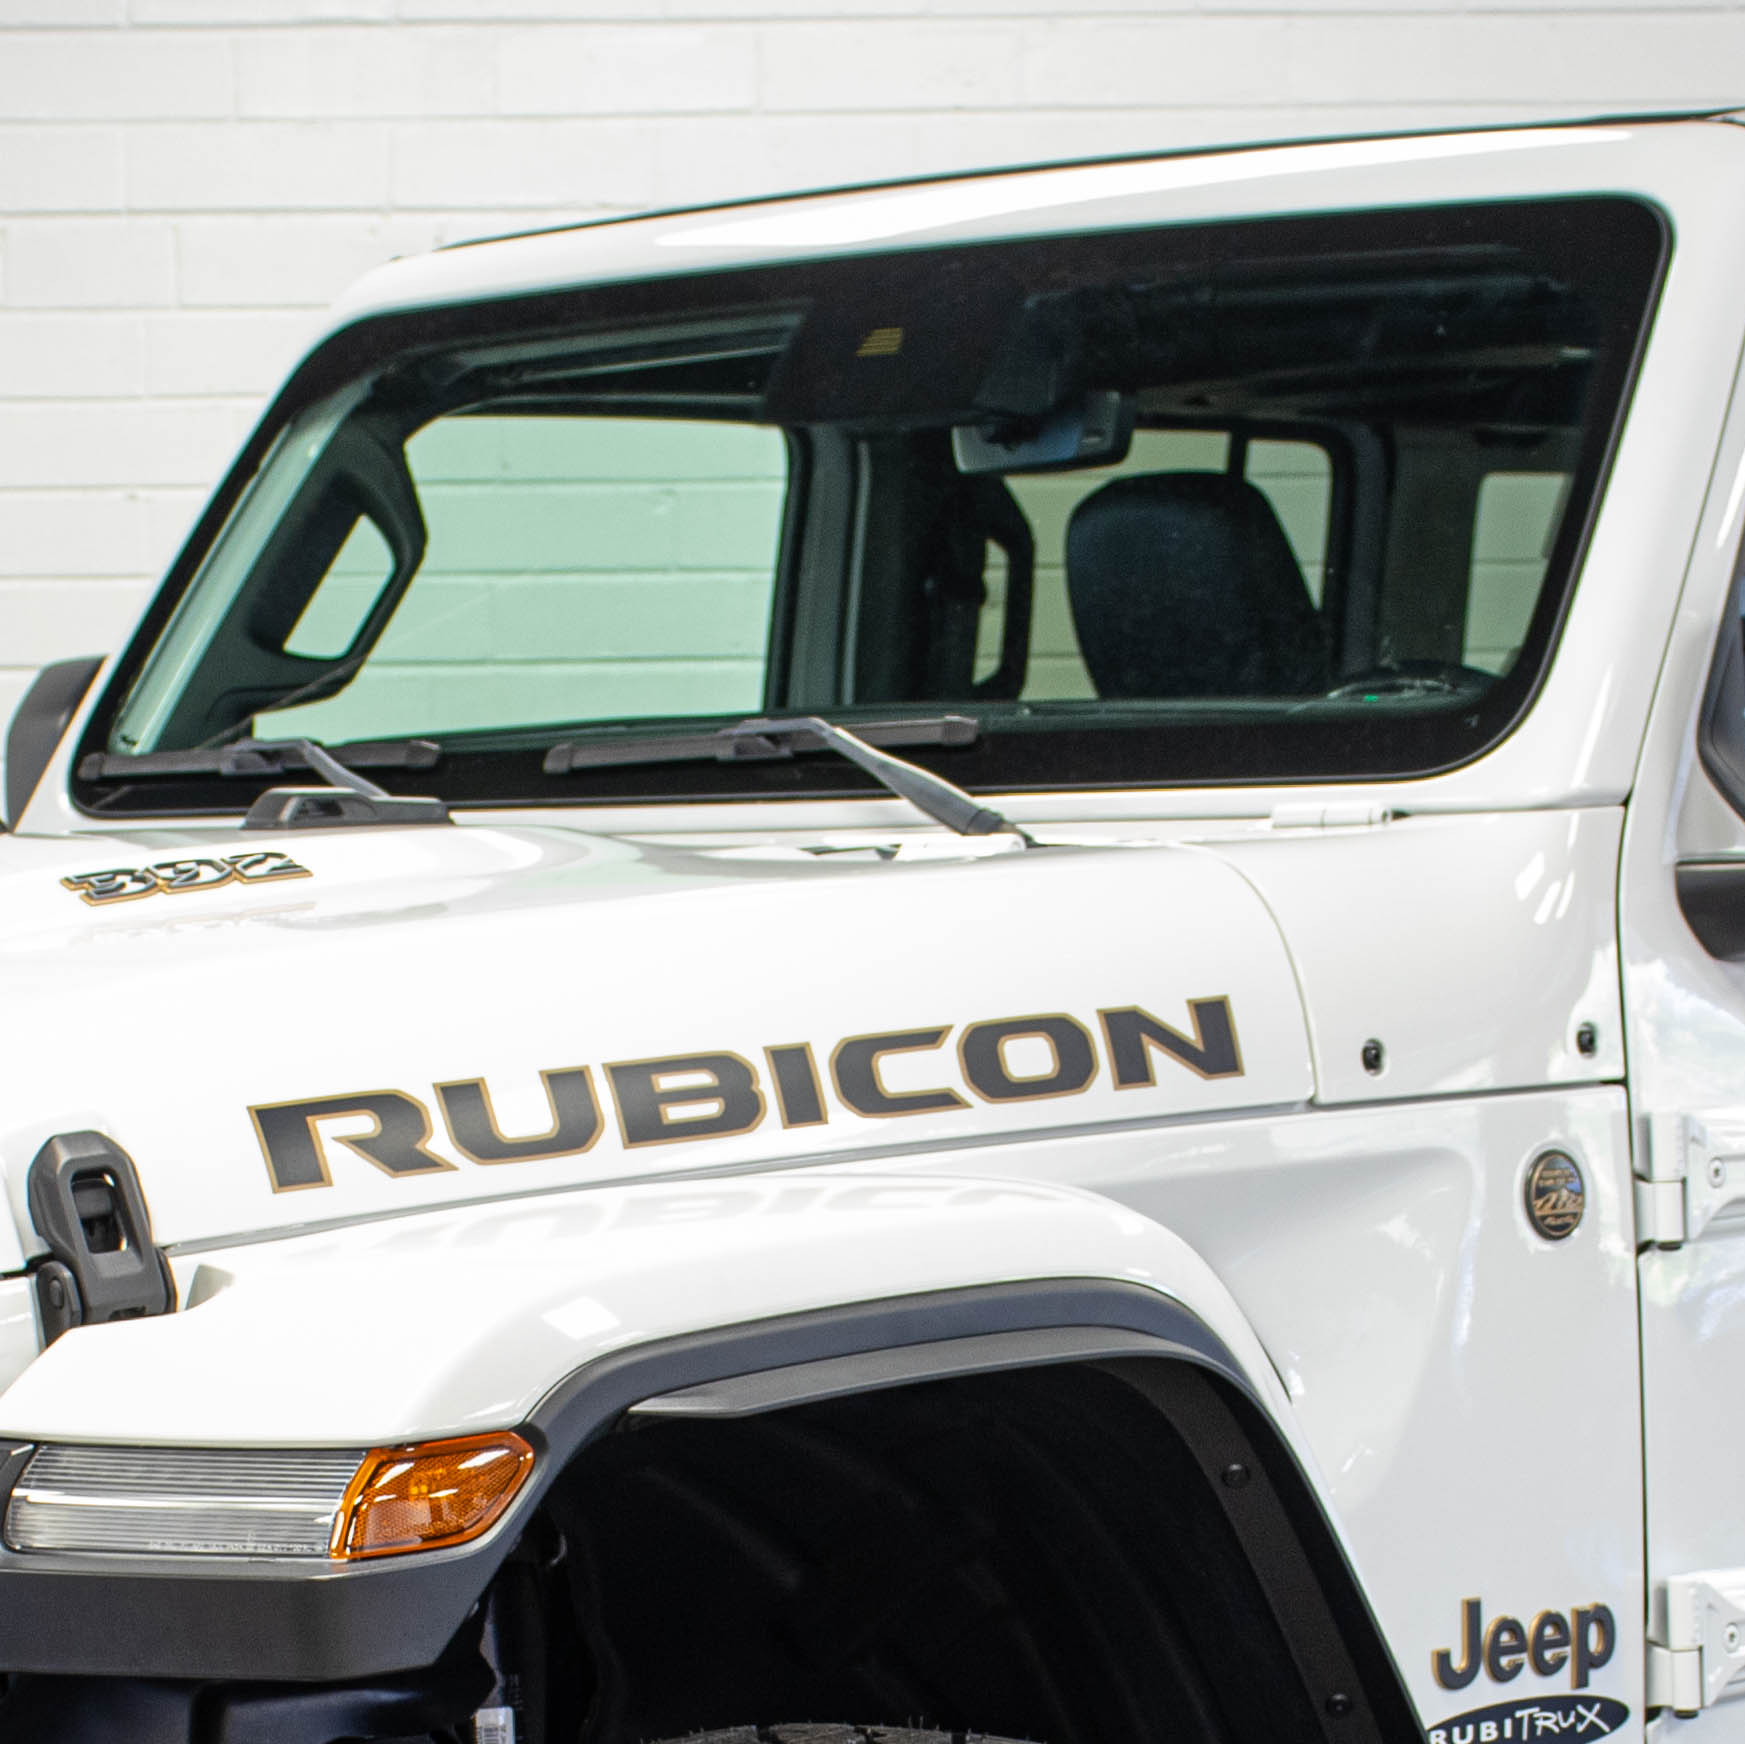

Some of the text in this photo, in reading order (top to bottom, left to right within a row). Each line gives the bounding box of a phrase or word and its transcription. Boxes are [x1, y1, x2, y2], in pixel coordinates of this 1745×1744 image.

[60, 851, 314, 907] 392
[245, 994, 1245, 1195] RUBICON
[1430, 1596, 1617, 1691] Jeep
